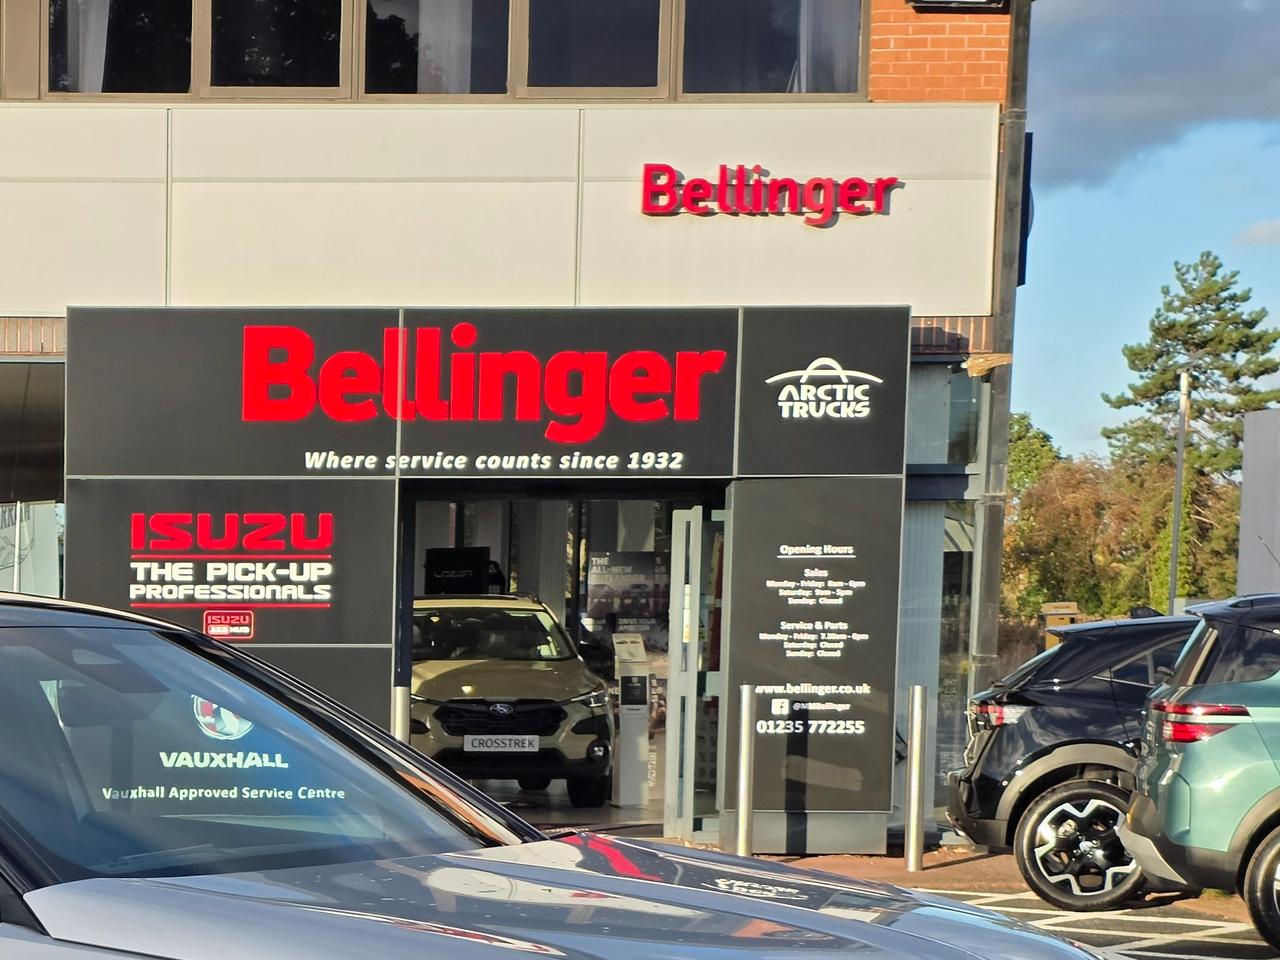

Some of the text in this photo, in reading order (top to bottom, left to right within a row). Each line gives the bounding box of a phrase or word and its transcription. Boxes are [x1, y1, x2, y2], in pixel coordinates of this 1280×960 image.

[641, 163, 899, 225] Bellinger
[241, 321, 727, 445] Bellinger
[778, 384, 870, 401] ARCTIC
[777, 401, 871, 418] TRUCKS
[304, 451, 684, 469] Where service counts since 1932
[130, 512, 334, 550] ISUZU
[779, 544, 854, 555] Opening Hours
[130, 562, 332, 582] THE PICK-UP
[803, 568, 829, 577] Sales
[129, 584, 332, 600] PROFESSIONALS
[208, 615, 250, 624] ISUZU
[780, 621, 849, 630] Service & Parts
[756, 720, 865, 734] 01235 772255
[471, 738, 536, 749] CROSSTREK
[159, 751, 289, 768] VAUXHALL
[102, 786, 345, 801] Vauxhall Approved Service Centre
